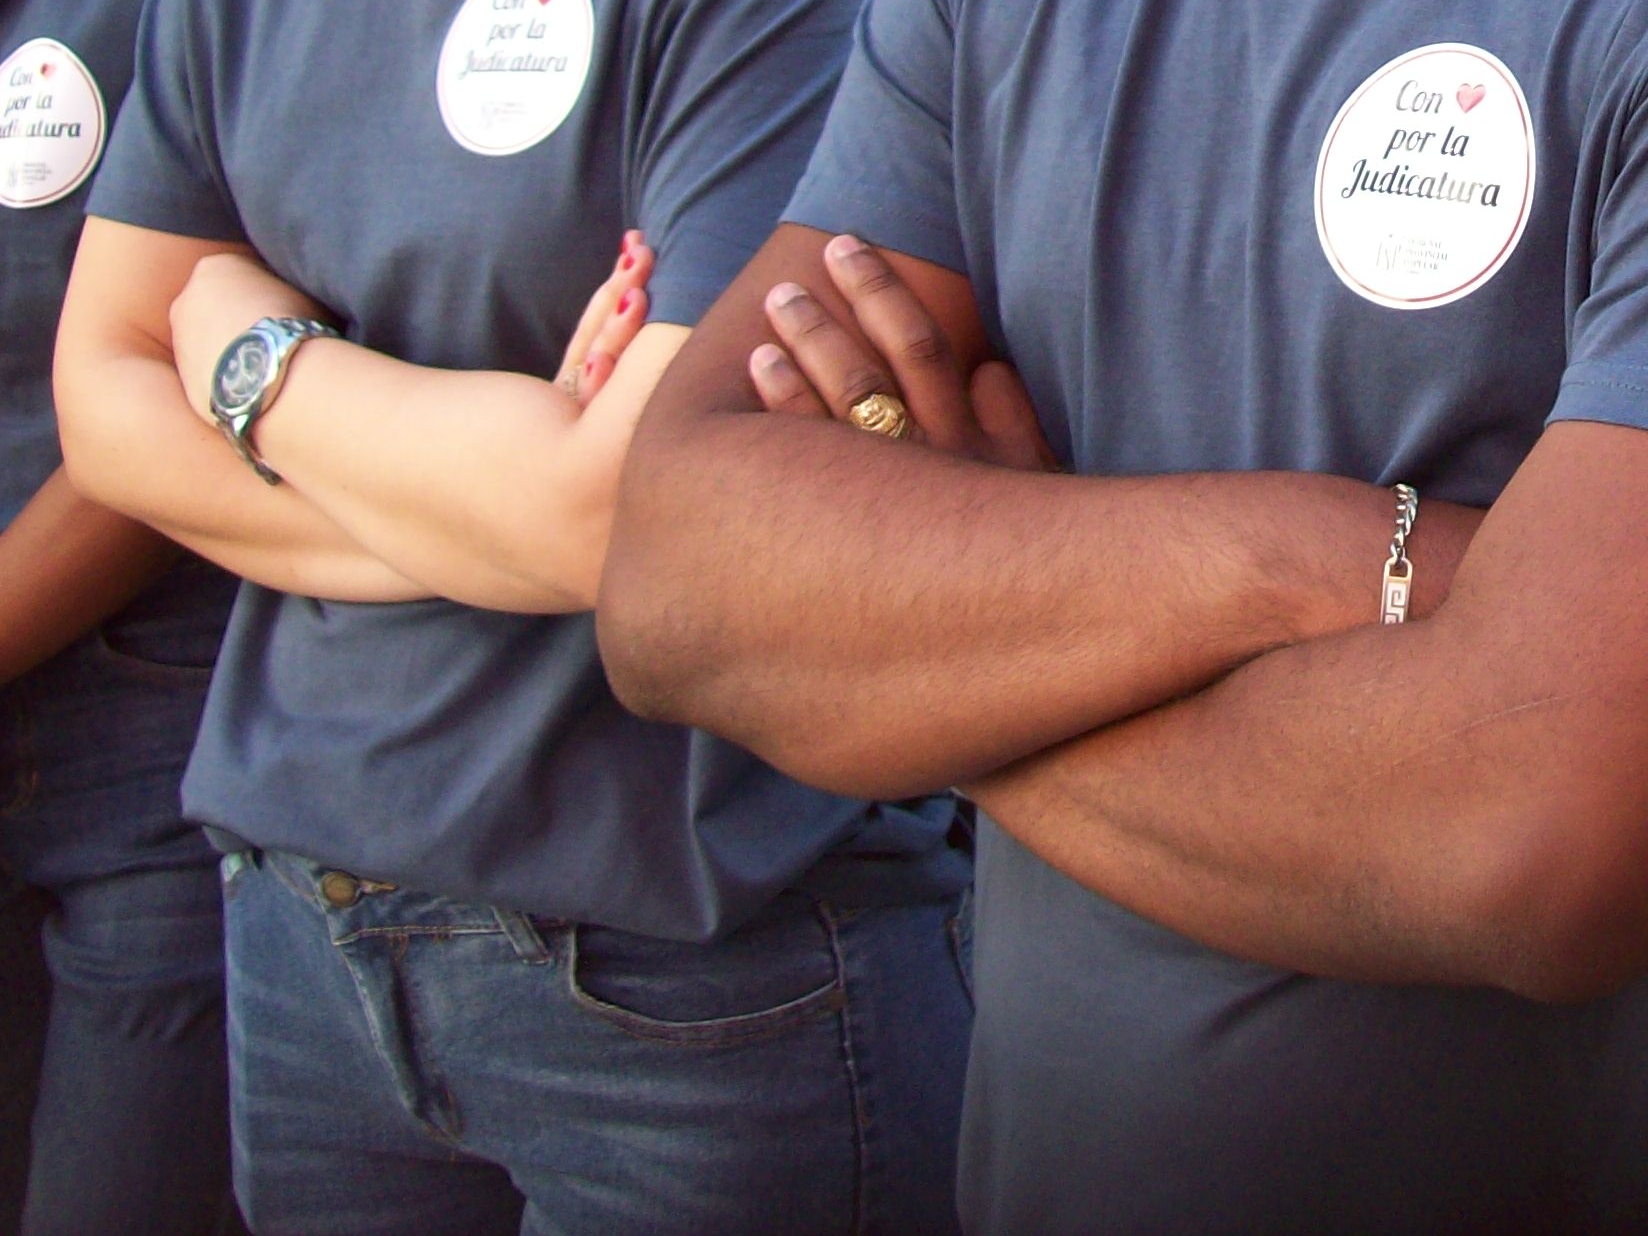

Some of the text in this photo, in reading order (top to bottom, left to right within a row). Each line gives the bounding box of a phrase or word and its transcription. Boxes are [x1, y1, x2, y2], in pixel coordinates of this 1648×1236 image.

[486, 18, 547, 47] por la
[457, 50, 568, 80] Judicatura
[1395, 80, 1443, 113] Con
[1383, 126, 1469, 159] por la
[1341, 159, 1500, 207] Judicatura
